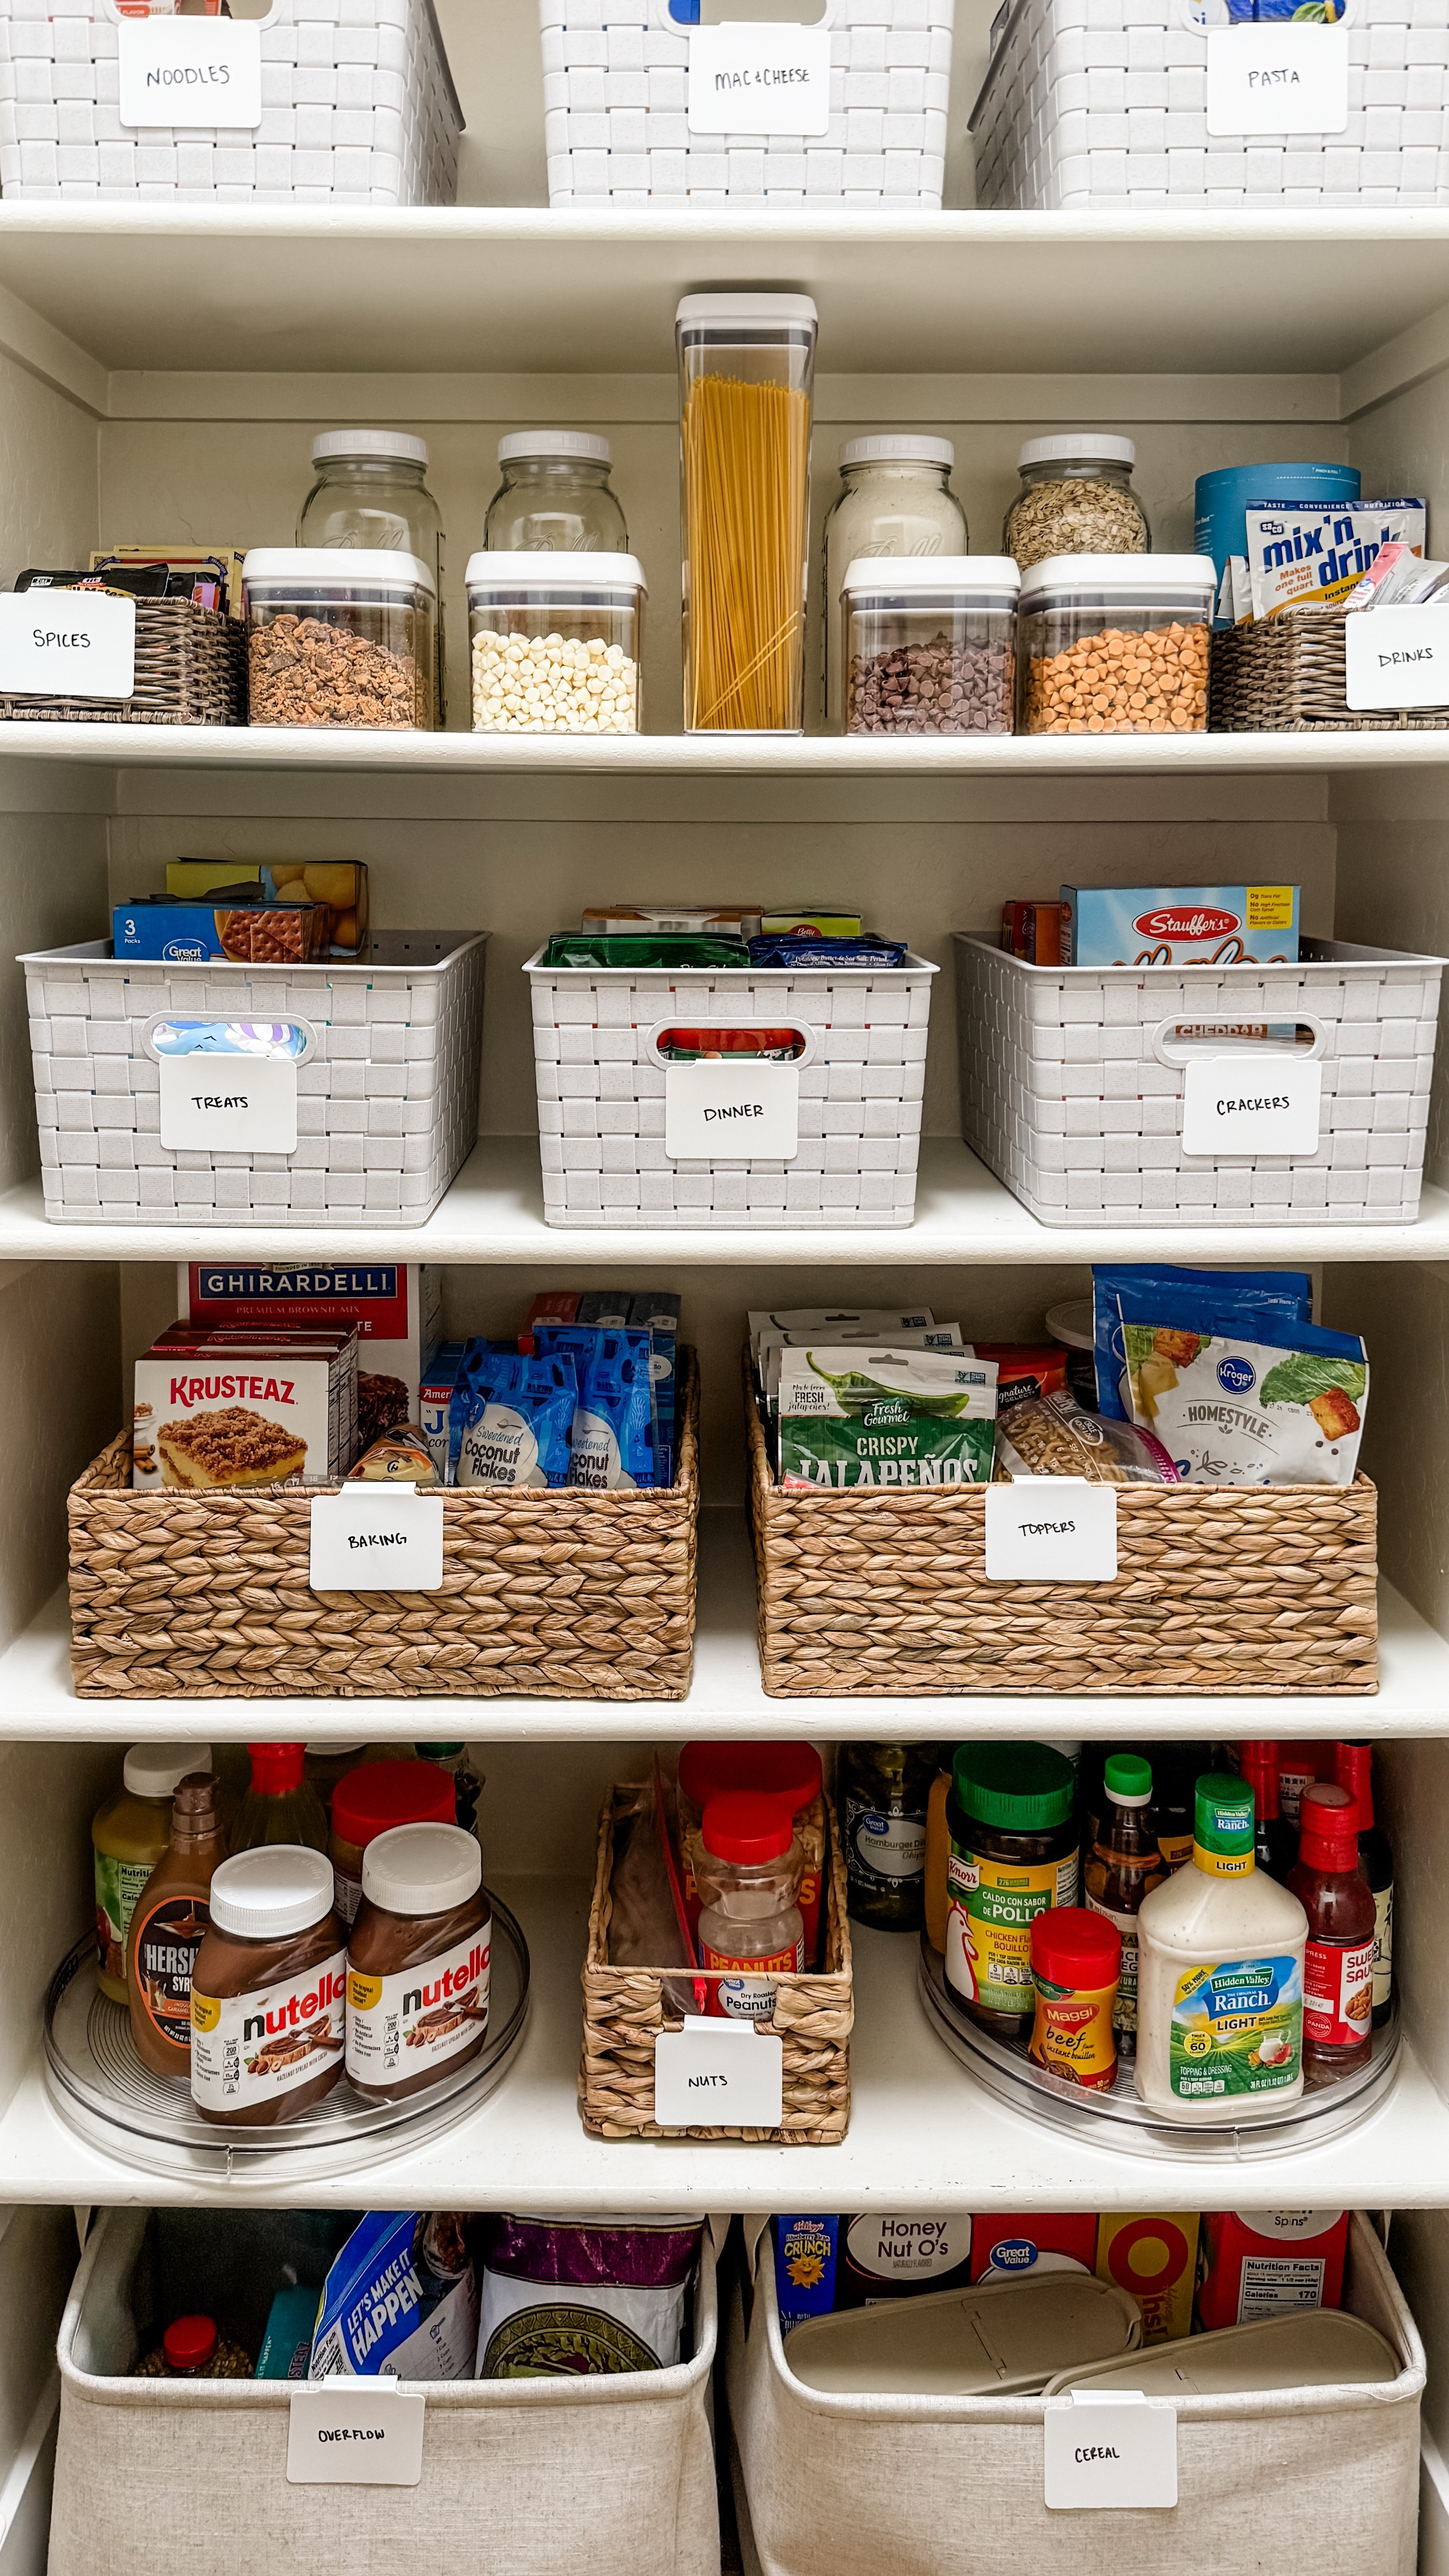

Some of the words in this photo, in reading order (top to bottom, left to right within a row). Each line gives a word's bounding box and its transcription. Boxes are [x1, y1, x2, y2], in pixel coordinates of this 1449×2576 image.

[147, 65, 229, 87] NOODLES
[715, 70, 751, 90] MAC
[764, 69, 810, 86] CHEESE
[1248, 69, 1300, 87] PASTA
[1263, 526, 1324, 574] mix
[1279, 564, 1311, 580] Makes
[1275, 580, 1293, 593] one
[1296, 572, 1312, 585] full
[1286, 580, 1314, 596] quart
[33, 630, 91, 648] SPICES
[1378, 648, 1433, 667] DRINKS
[124, 919, 136, 936] 3
[798, 928, 815, 936] Betty
[1149, 913, 1228, 936] Stauffer's
[169, 946, 202, 958] Great
[191, 1096, 248, 1109] TREATS
[1217, 1096, 1290, 1116] CRACKERS
[704, 1104, 764, 1122] DINNER
[207, 1274, 387, 1293] GHIRARDELLI
[1220, 1363, 1253, 1387] Kroger
[170, 1375, 296, 1408] KRUSTEAZ
[795, 1391, 824, 1403] FRESH
[1004, 1391, 1032, 1403] SELECT
[871, 1400, 902, 1417] Fresh
[863, 1412, 909, 1427] Gourmet
[1188, 1405, 1270, 1439] HOMESTYLE
[477, 1426, 523, 1445] Sweetened
[465, 1437, 520, 1464] Coconut
[857, 1436, 919, 1456] CRISPY
[471, 1457, 516, 1482] Flakes
[1018, 1521, 1076, 1536] TOPPERS
[348, 1532, 407, 1549] BAKING
[866, 1817, 884, 1828] Great
[1217, 1818, 1248, 1830] Ranch
[865, 1835, 913, 1849] Hamburger
[949, 1861, 977, 1884] Knorr
[1216, 1861, 1247, 1871] LIGHT
[999, 1878, 1009, 1886] 226
[982, 1891, 1005, 1904] CALDO
[1007, 1897, 1023, 1906] CON
[1023, 1897, 1046, 1906] SABOR
[983, 1906, 991, 1916] DE
[986, 1930, 1018, 1942] CHICKEN
[994, 1941, 1030, 1953] BOUILLO
[710, 1952, 792, 1972] PEANUTS
[403, 1944, 491, 2016] nutella
[1181, 1980, 1193, 1992] 50%
[1192, 1969, 1206, 1983] MORE
[1214, 1976, 1245, 1988] Hidden
[1245, 1976, 1270, 1984] Valley
[244, 1972, 346, 2042] nutella
[726, 1996, 776, 2010] Peanuts
[1217, 2017, 1257, 2031] LIGHT
[1307, 2020, 1330, 2030] PANDA
[1046, 2026, 1086, 2050] beef
[1190, 2042, 1206, 2051] 60
[1047, 2043, 1070, 2058] instant
[1071, 2050, 1096, 2060] bouillon
[276, 2070, 294, 2082] HAZELNUT
[295, 2064, 308, 2075] SPREAD
[1180, 2066, 1202, 2076] TOPPING
[1208, 2065, 1232, 2075] DRESSING
[688, 2075, 728, 2088] NUTS
[786, 2233, 815, 2242] Blueberry
[815, 2233, 830, 2242] Bran
[881, 2220, 947, 2238] Honey
[784, 2240, 831, 2257] CRUNCH
[877, 2240, 912, 2258] Nut
[918, 2239, 949, 2255] O's
[996, 2247, 1030, 2258] Great
[1003, 2256, 1030, 2264] Value
[1247, 2262, 1290, 2271] Nutrition
[347, 2294, 372, 2336] LET'S
[370, 2260, 399, 2304] MAKE
[399, 2248, 411, 2271] IT
[351, 2267, 424, 2366] HAPPEN
[311, 2346, 327, 2372] Nutrition
[318, 2429, 385, 2442] OVERFLOW
[1075, 2447, 1120, 2463] CEREAL
